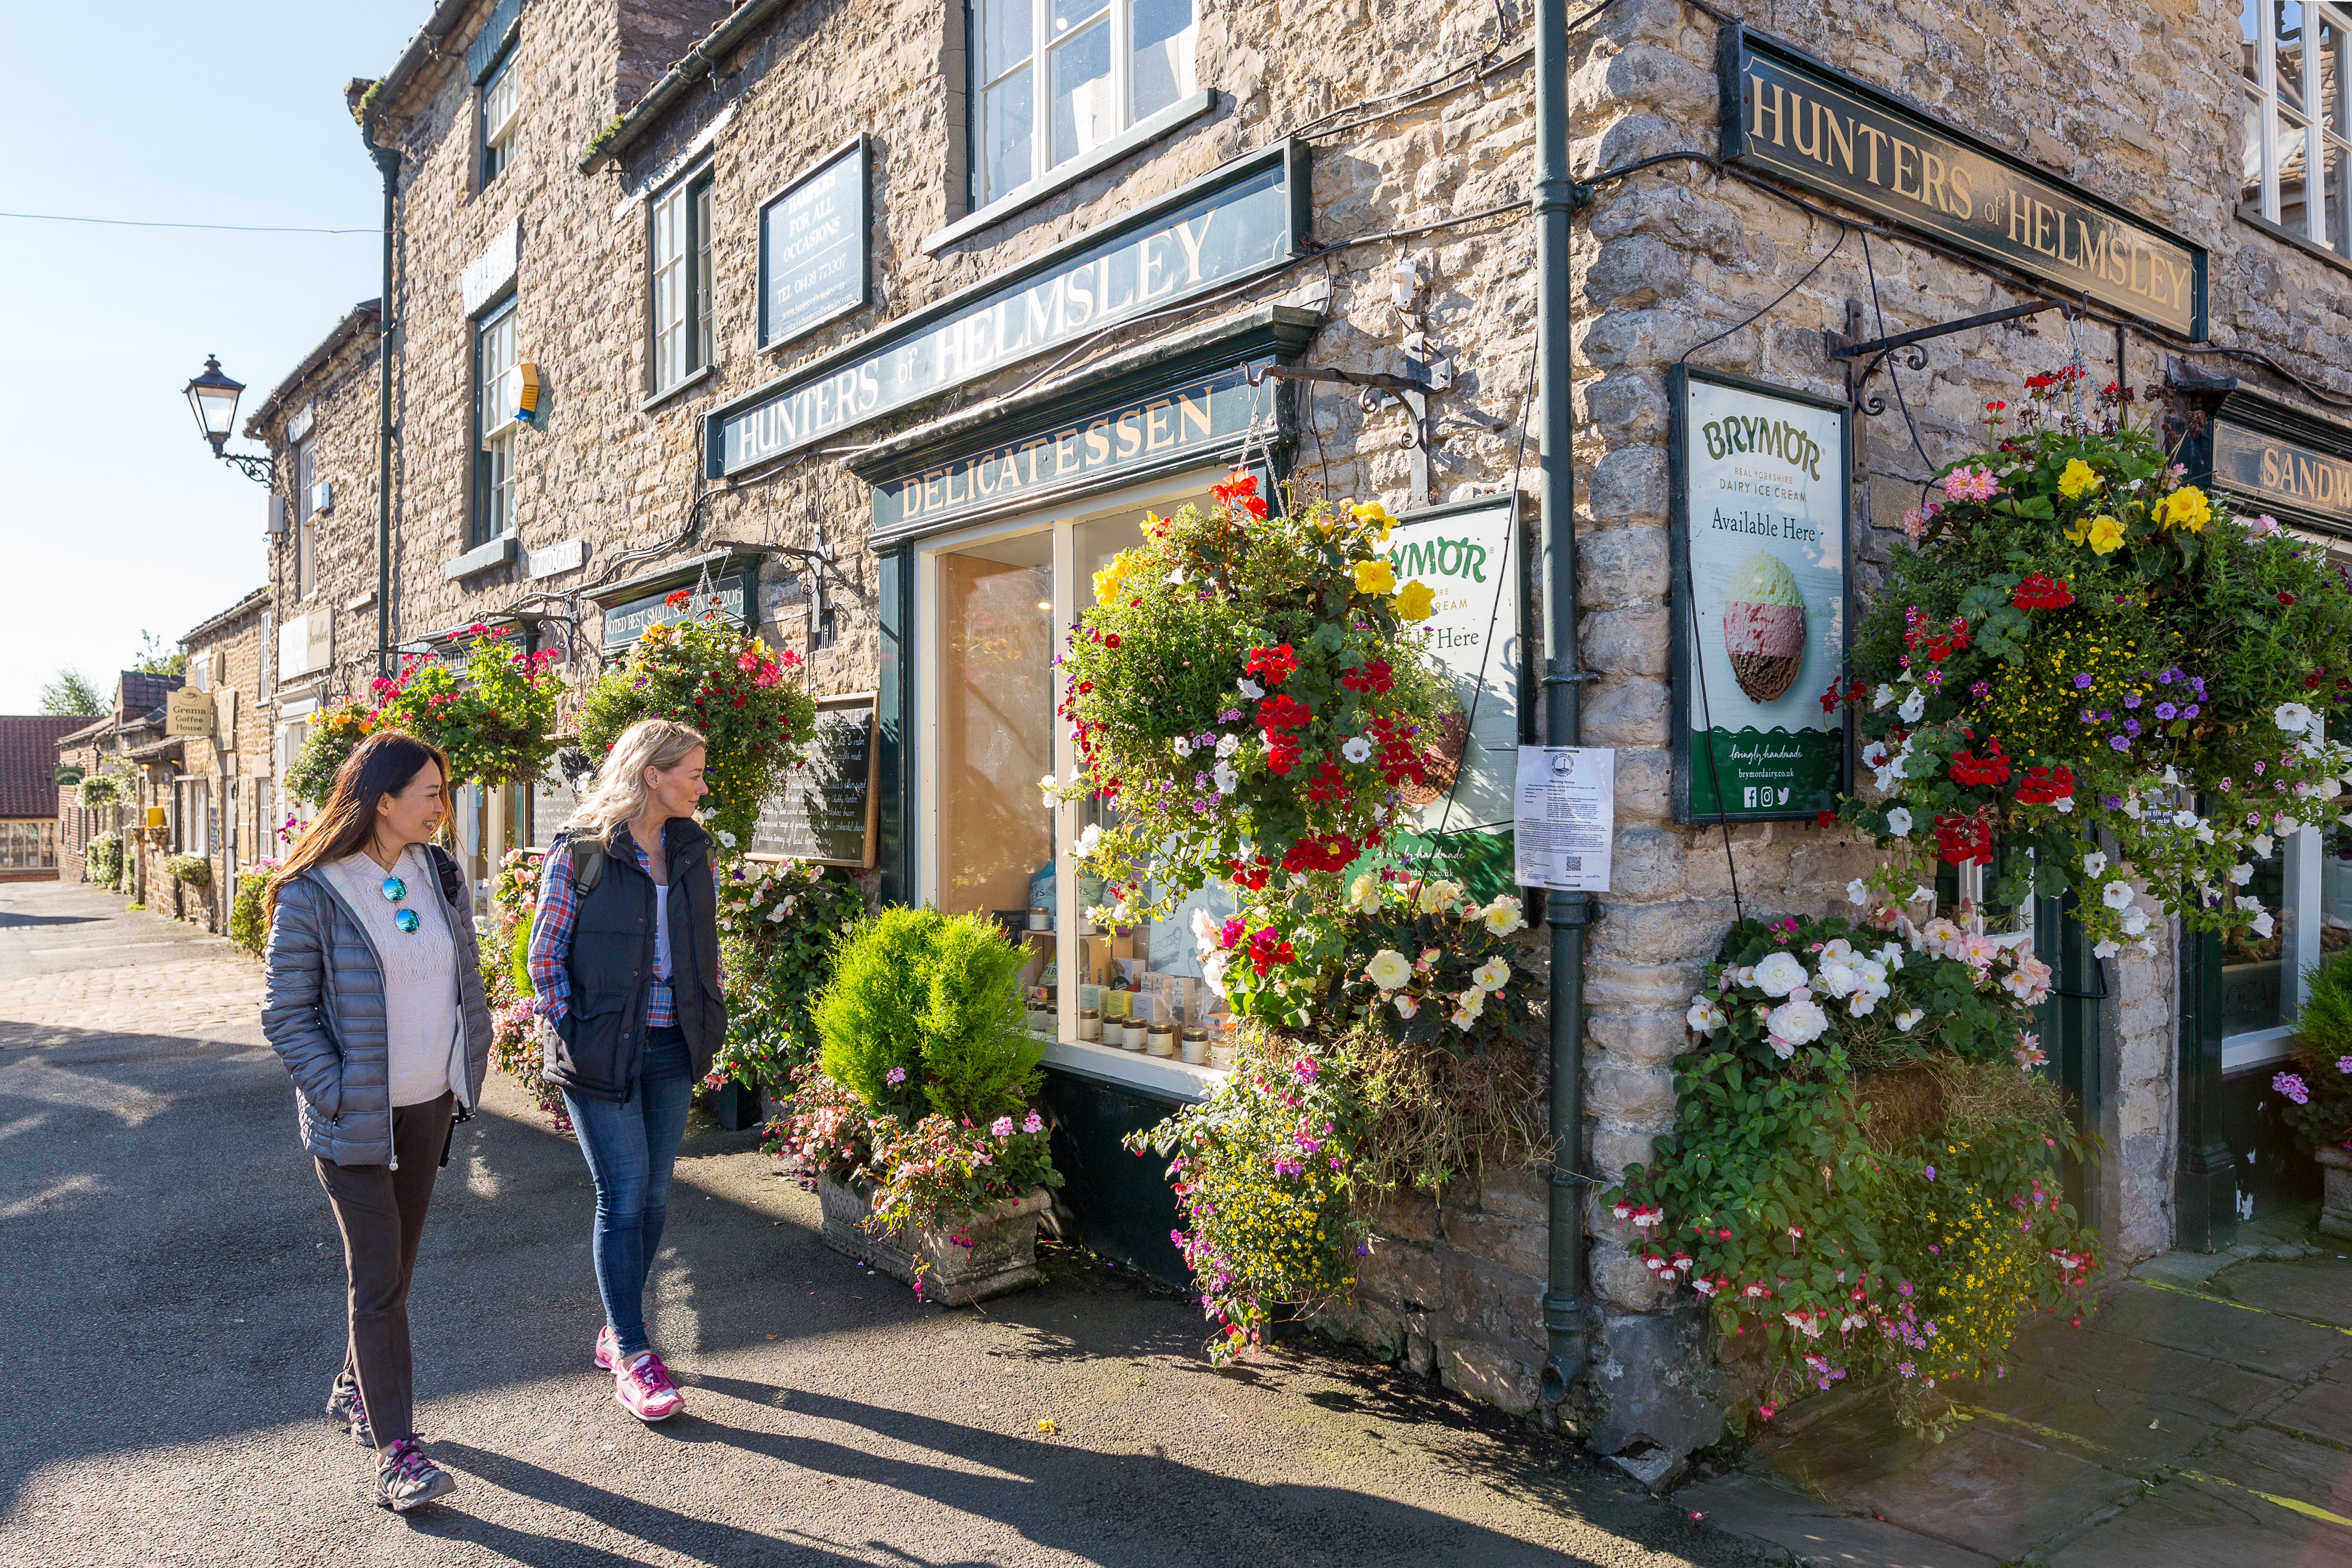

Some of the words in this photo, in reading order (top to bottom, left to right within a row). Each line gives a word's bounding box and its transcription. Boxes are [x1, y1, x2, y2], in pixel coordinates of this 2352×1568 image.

[788, 170, 836, 216] HAMPERS
[1748, 72, 1973, 220] HUNTERS
[1985, 195, 2005, 226] of
[2006, 187, 2188, 312] HELMSLEY
[789, 211, 810, 239] FOR
[812, 196, 834, 225] ALL
[783, 215, 841, 263] OCCASIONS
[777, 284, 793, 304] TEL
[795, 271, 816, 294] 01439
[819, 253, 847, 281] 771307
[739, 357, 879, 461] HUNTERS
[898, 347, 918, 384] of
[935, 205, 1218, 383] HELMSLEY
[902, 385, 1214, 518] DELICATESSEN
[1720, 479, 1750, 493] DAIRY
[1755, 484, 1770, 496] ICE
[1775, 488, 1807, 502] CREAM
[1735, 467, 1751, 477] REAL
[1754, 470, 1793, 484] YORKSHIRE
[1712, 507, 1778, 536] Available
[1783, 517, 1815, 541] Here
[532, 553, 553, 574] BORO
[557, 544, 579, 567] GATE
[1376, 536, 1487, 583] YMOR
[606, 617, 627, 635] VOTED
[628, 610, 645, 631] BEST
[647, 605, 672, 625] SMALL
[674, 598, 695, 618] SHP
[721, 587, 742, 607] 2015
[1431, 599, 1467, 611] REAM
[1437, 628, 1479, 648] Here
[1552, 768, 1566, 777] NATIONAL
[1730, 744, 1762, 765] lovingly
[1762, 744, 1803, 758] handmade
[1739, 768, 1794, 780] brymordairy.co.uk
